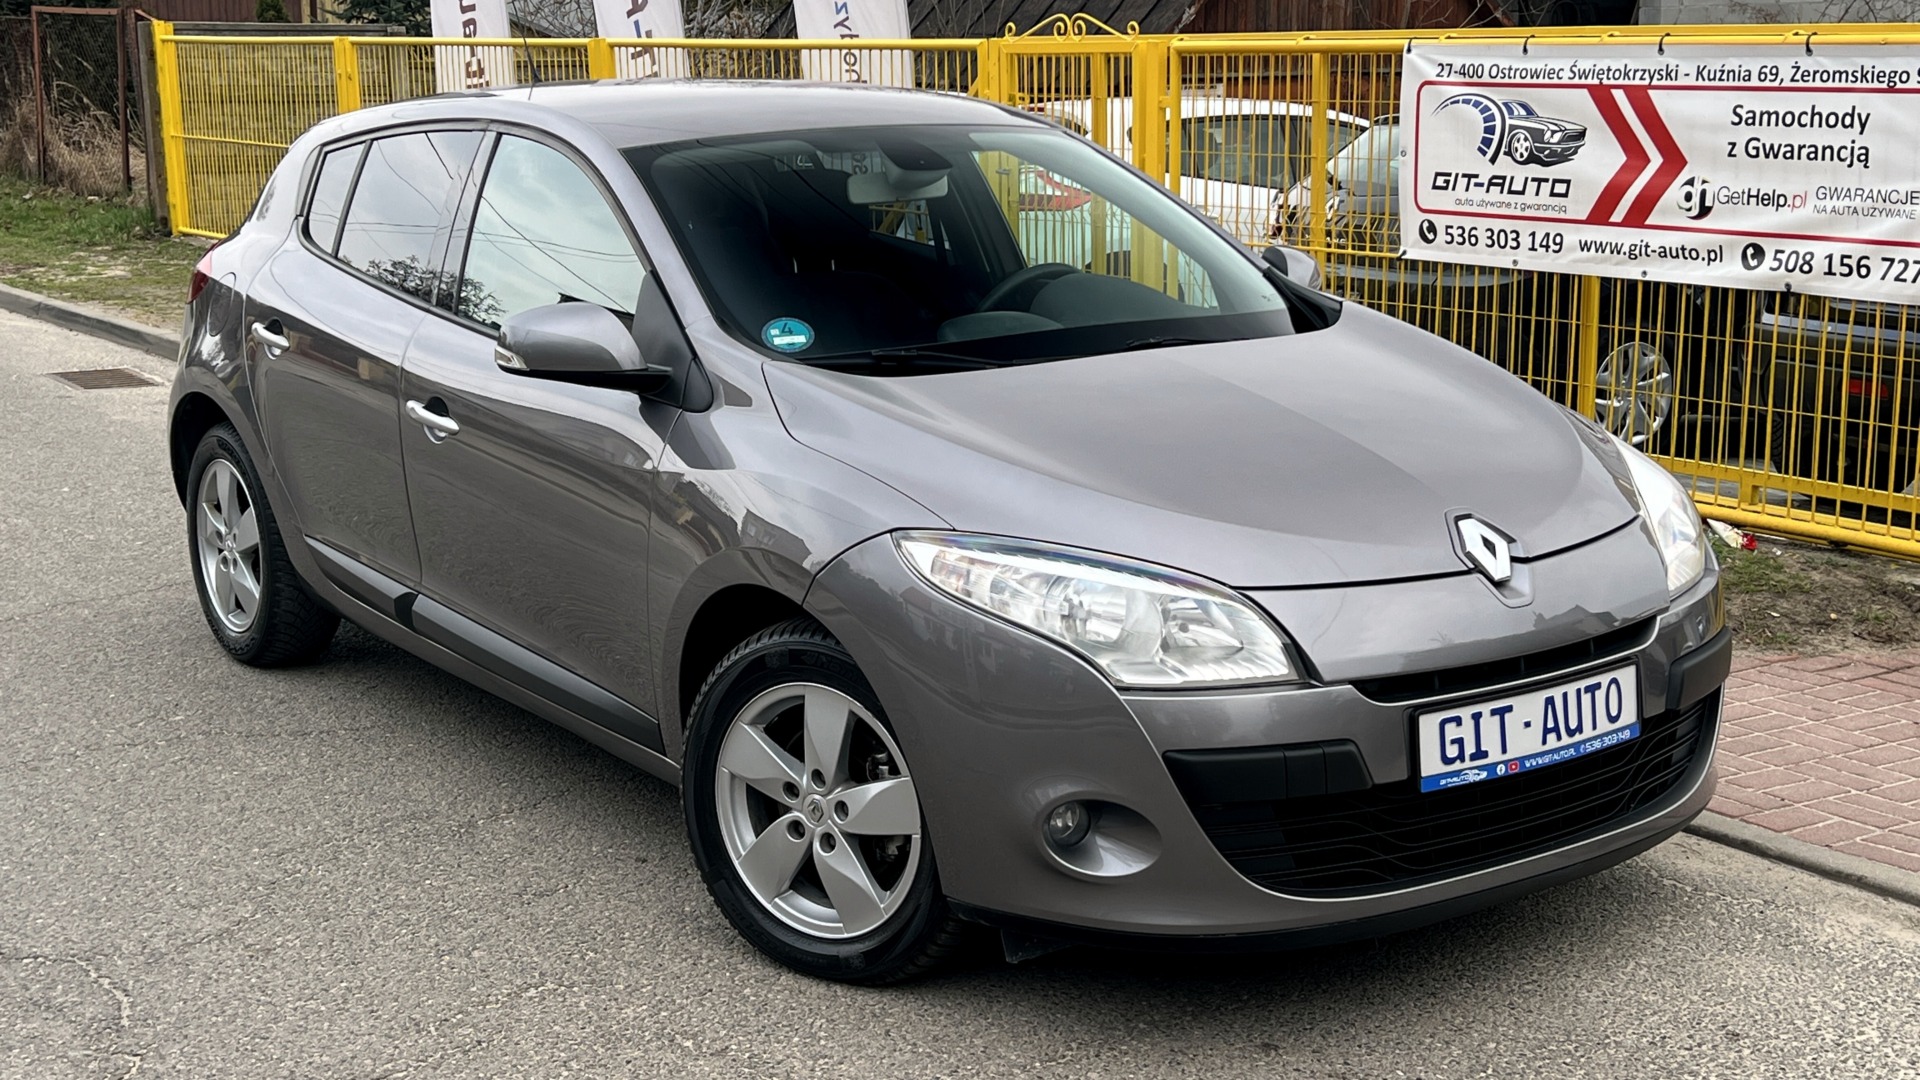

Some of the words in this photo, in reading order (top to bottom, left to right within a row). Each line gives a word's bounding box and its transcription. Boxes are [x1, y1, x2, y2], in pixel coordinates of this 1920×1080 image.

[1435, 62, 1485, 79] 27-400
[1488, 64, 1565, 81] Ostrowiec
[1568, 60, 1679, 85] Świętokrzyski
[1695, 64, 1751, 82] Kuźnia
[1757, 65, 1784, 86] 69,
[1789, 61, 1911, 88] Żeromskiego
[1730, 104, 1871, 135] Samochody
[1727, 141, 1738, 158] z
[1744, 137, 1870, 169] Gwarancją
[1431, 171, 1572, 198] GIT-AUTO
[1815, 186, 1920, 206] GWARANCJE
[1455, 197, 1474, 207] auta
[1475, 198, 1512, 210] używane
[1520, 201, 1567, 214] gwarancją
[1716, 185, 1808, 212] GetHelp.pl
[1813, 203, 1828, 215] NA
[1830, 204, 1859, 216] AUTA
[1862, 205, 1916, 220] UŻYWANE
[1444, 225, 1479, 247] 536
[1485, 228, 1521, 250] 303
[1527, 230, 1564, 254] 149
[1578, 238, 1723, 266] www.git-auto.pl
[1769, 249, 1815, 275] 508
[1823, 253, 1871, 279] 156
[1880, 256, 1920, 284] 727
[781, 322, 794, 335] 4
